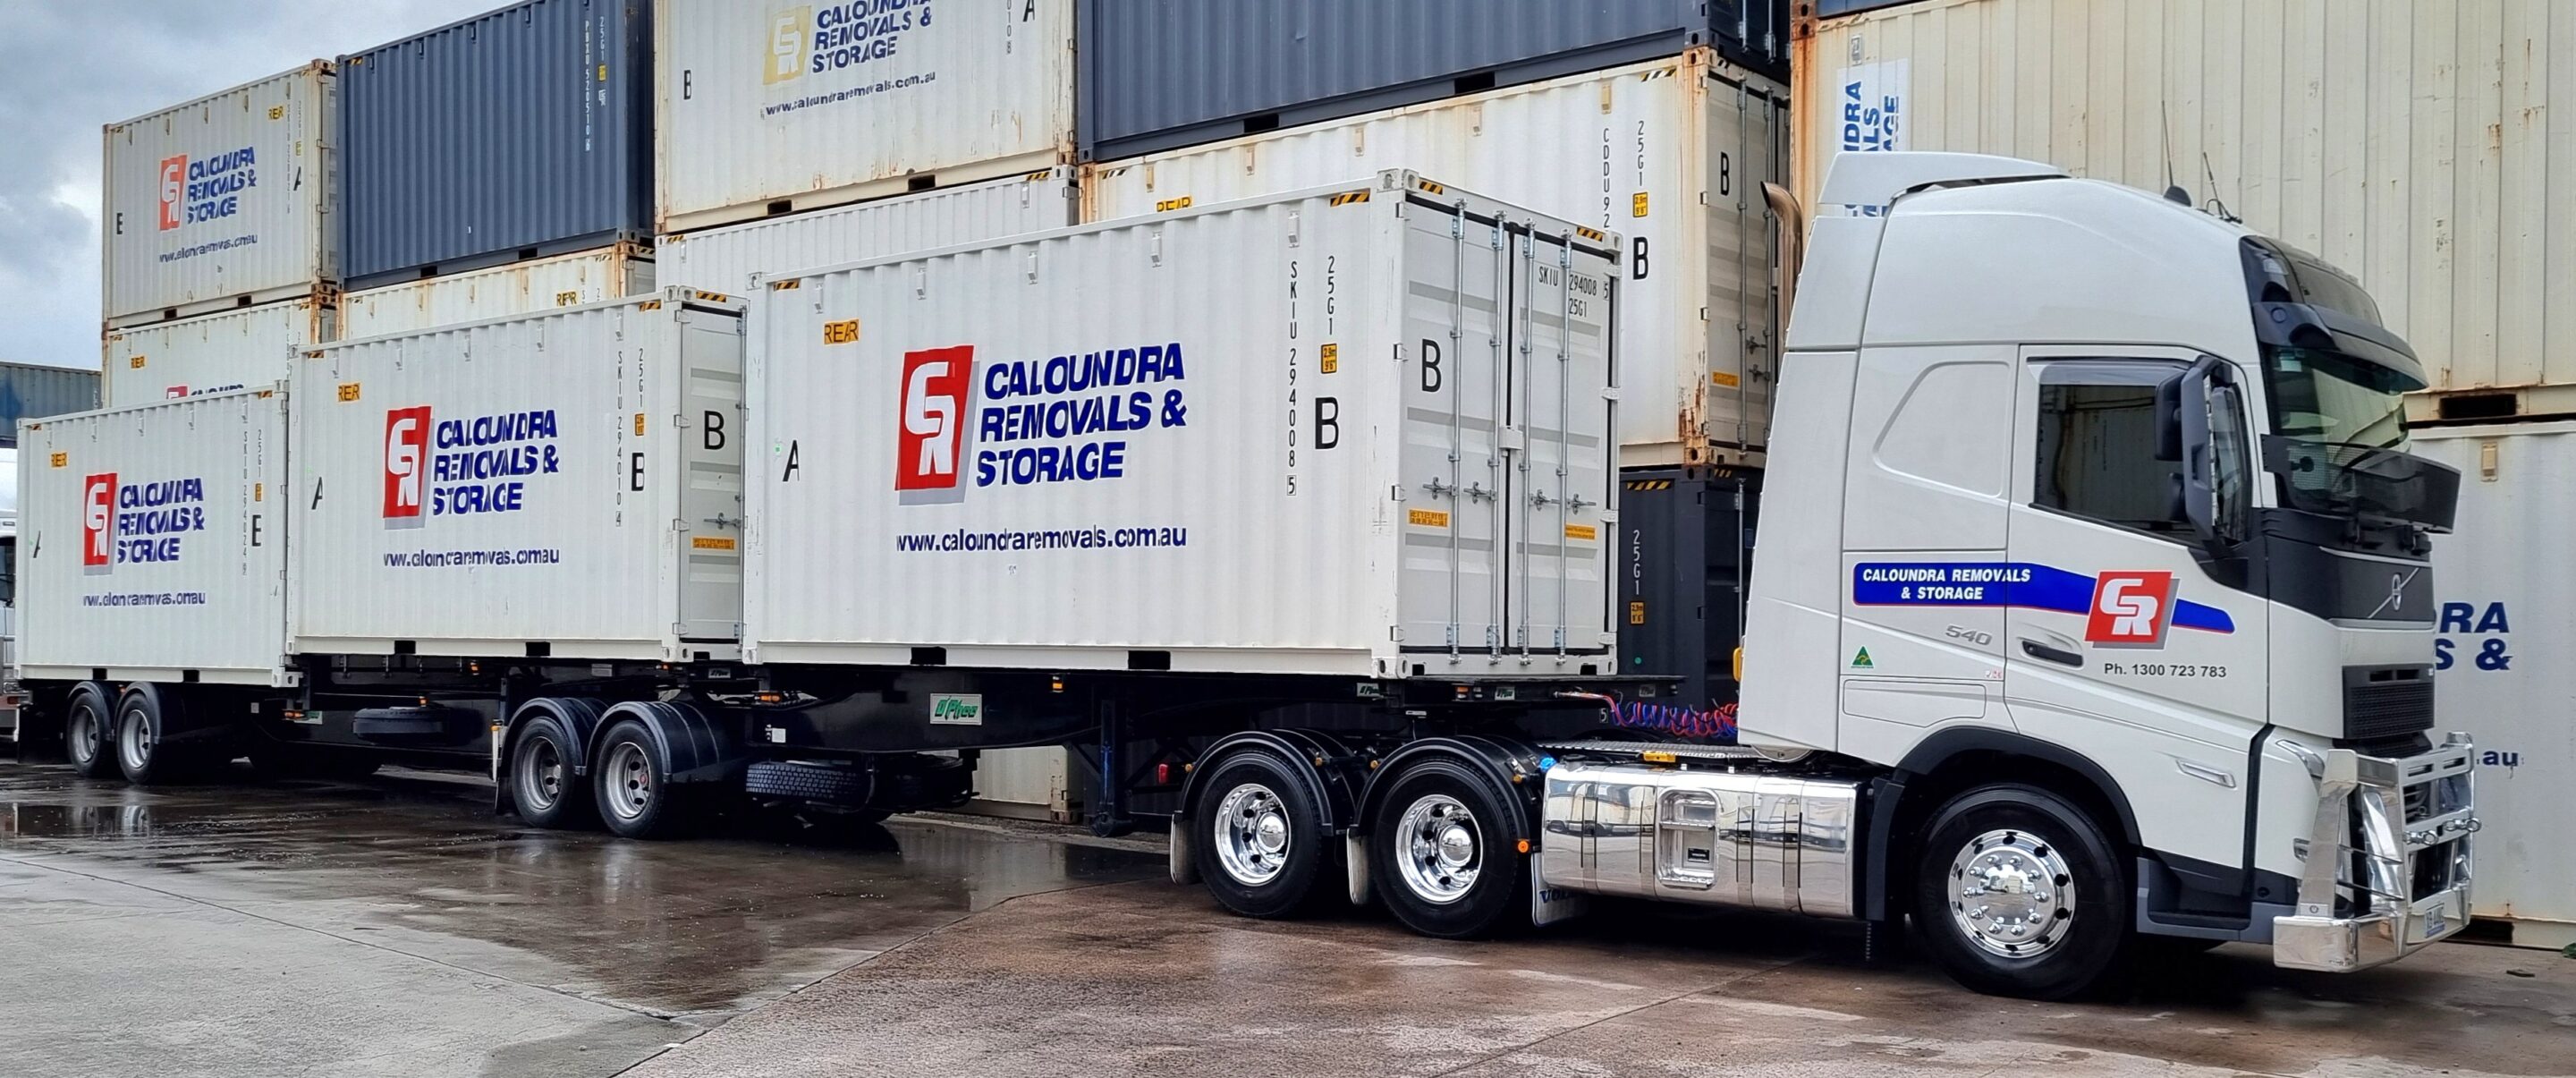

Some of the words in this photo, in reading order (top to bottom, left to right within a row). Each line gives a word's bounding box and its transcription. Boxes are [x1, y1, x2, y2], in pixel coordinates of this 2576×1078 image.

[815, 11, 912, 51] REMOVALS
[920, 6, 932, 28] &
[1022, 0, 1036, 22] A
[812, 36, 897, 73] STORAGE
[1721, 151, 1730, 197] B
[1633, 236, 1649, 281] B
[1290, 260, 1298, 340] SKIU
[1326, 255, 1335, 335] 25G1
[1538, 266, 1559, 287] SKIU
[1569, 273, 1597, 296] 294008
[1569, 297, 1588, 318] 25G1
[985, 343, 1185, 401] CALOUNDRA
[1422, 338, 1442, 394] B
[337, 383, 360, 402] RER
[1288, 347, 1297, 468] 294008
[436, 410, 558, 449] CALOUNDRA
[704, 410, 726, 451] B
[980, 391, 1152, 443] REMOVALS
[1161, 388, 1188, 429] &
[1315, 396, 1340, 450] B
[434, 446, 539, 482] REMOVALS
[543, 444, 560, 474] &
[783, 439, 801, 482] A
[976, 441, 1126, 488] STORAGE
[433, 482, 524, 516] STORAGE
[896, 525, 1187, 552] www.caloundraremovals.com.au
[1632, 529, 1641, 596] 25G1
[1862, 568, 1946, 582] CALOUNDRA
[1952, 568, 2031, 582] REMOVALS
[1901, 586, 1911, 600] &
[1917, 586, 1984, 600] STORAGE
[1945, 625, 1993, 646] 540
[2475, 638, 2513, 671] &
[2104, 663, 2127, 675] Ph.
[2131, 664, 2165, 676] 1300
[2170, 665, 2196, 677] 723
[2200, 666, 2227, 678] 783
